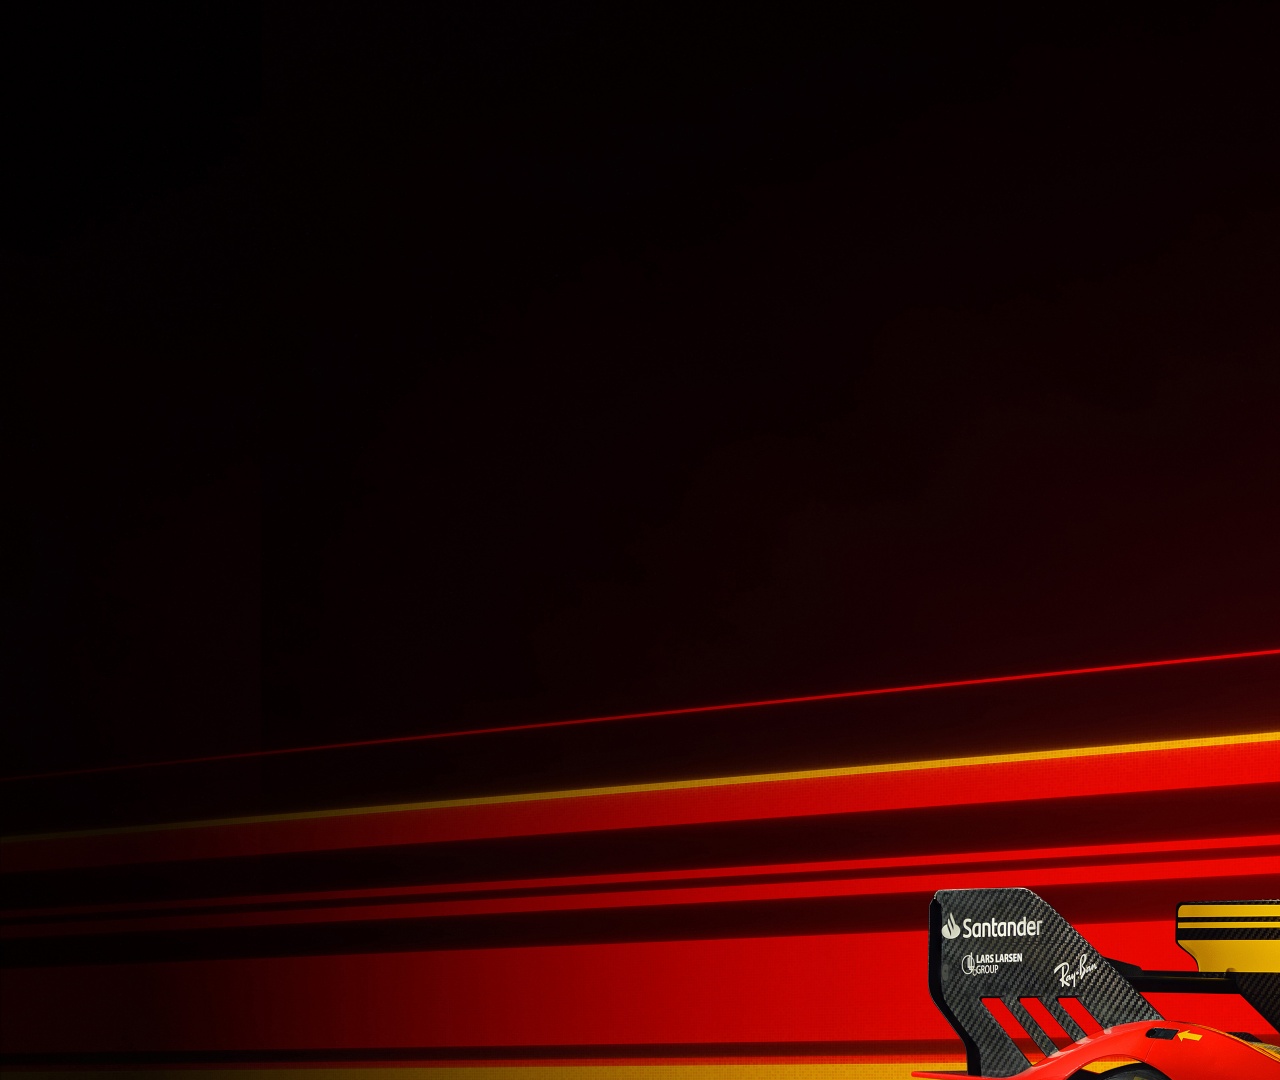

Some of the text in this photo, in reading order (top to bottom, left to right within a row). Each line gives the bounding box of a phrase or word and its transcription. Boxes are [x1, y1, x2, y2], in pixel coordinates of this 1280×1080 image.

[962, 916, 1044, 938] Santander
[976, 953, 1023, 963] LARS LARSEN
[976, 964, 999, 974] GROUP
